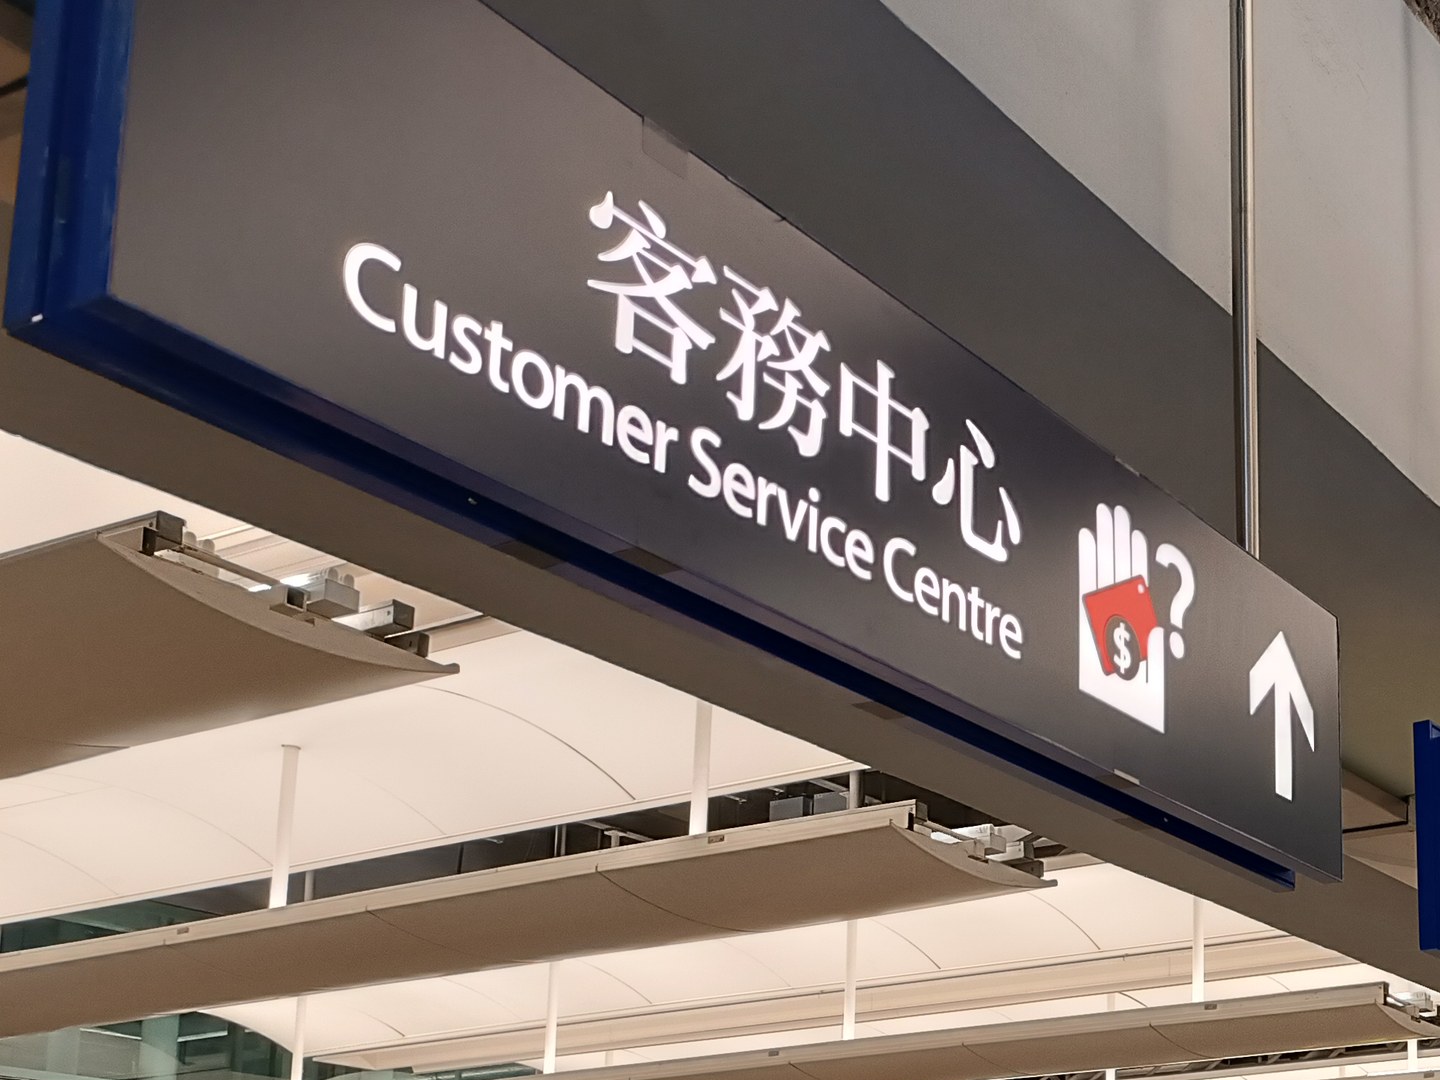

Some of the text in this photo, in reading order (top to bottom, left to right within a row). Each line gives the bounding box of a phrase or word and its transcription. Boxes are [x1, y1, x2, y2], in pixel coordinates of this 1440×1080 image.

[342, 241, 1024, 660] Customer Service Centre
[587, 189, 1021, 563] 客務中心
